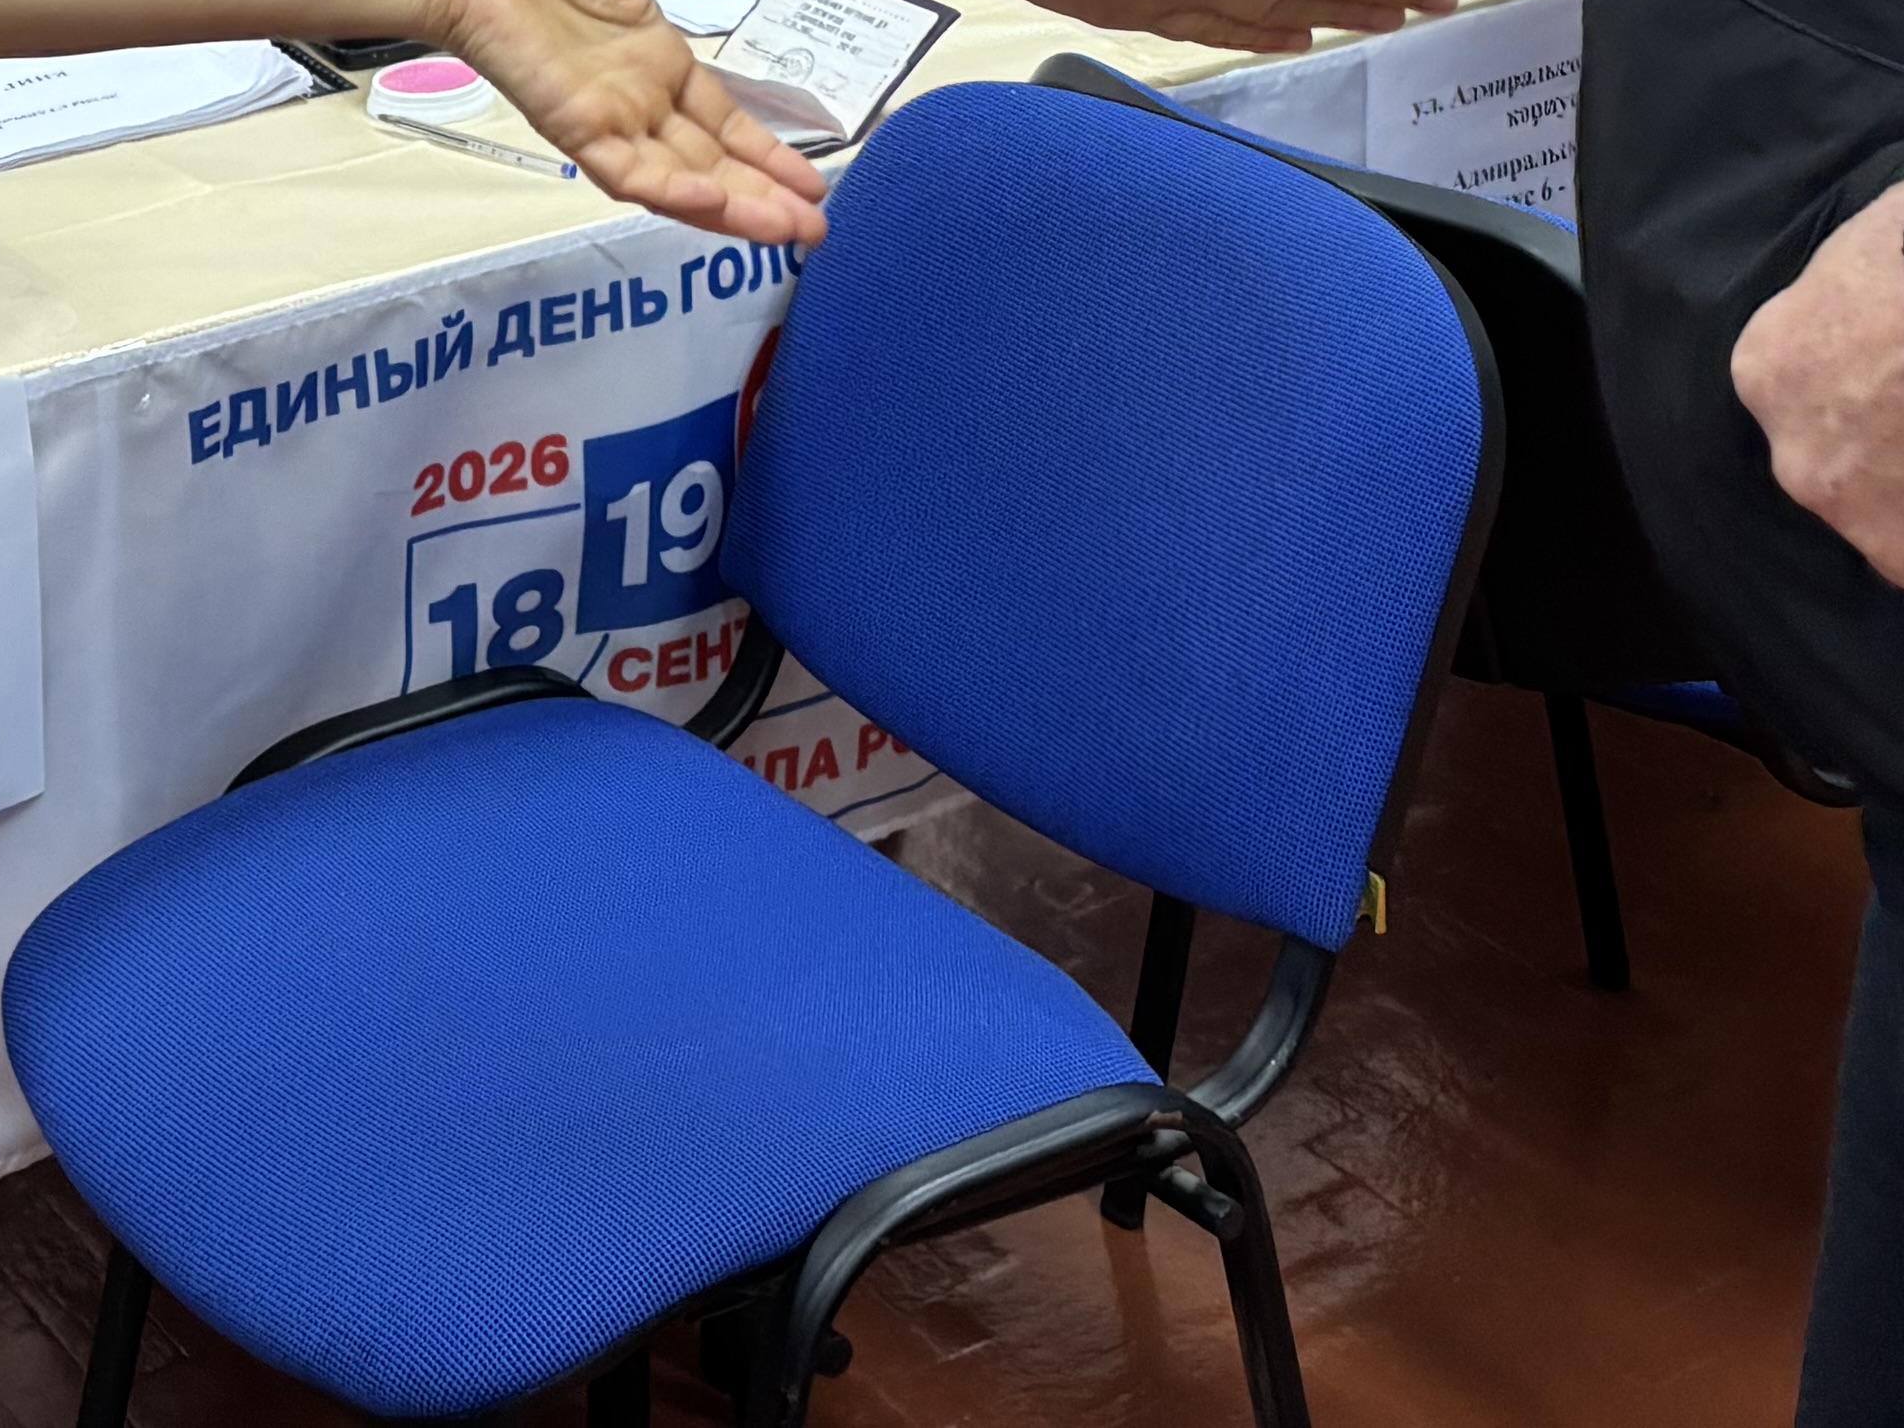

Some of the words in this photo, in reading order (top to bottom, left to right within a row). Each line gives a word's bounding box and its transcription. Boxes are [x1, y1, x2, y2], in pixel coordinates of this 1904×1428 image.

[188, 308, 474, 466] ЕДИНЫЙ
[487, 276, 669, 367] ДЕНЬ
[411, 434, 569, 517] 2026
[606, 460, 724, 586] 19
[428, 569, 564, 679] 18
[608, 618, 747, 693] СЕН
